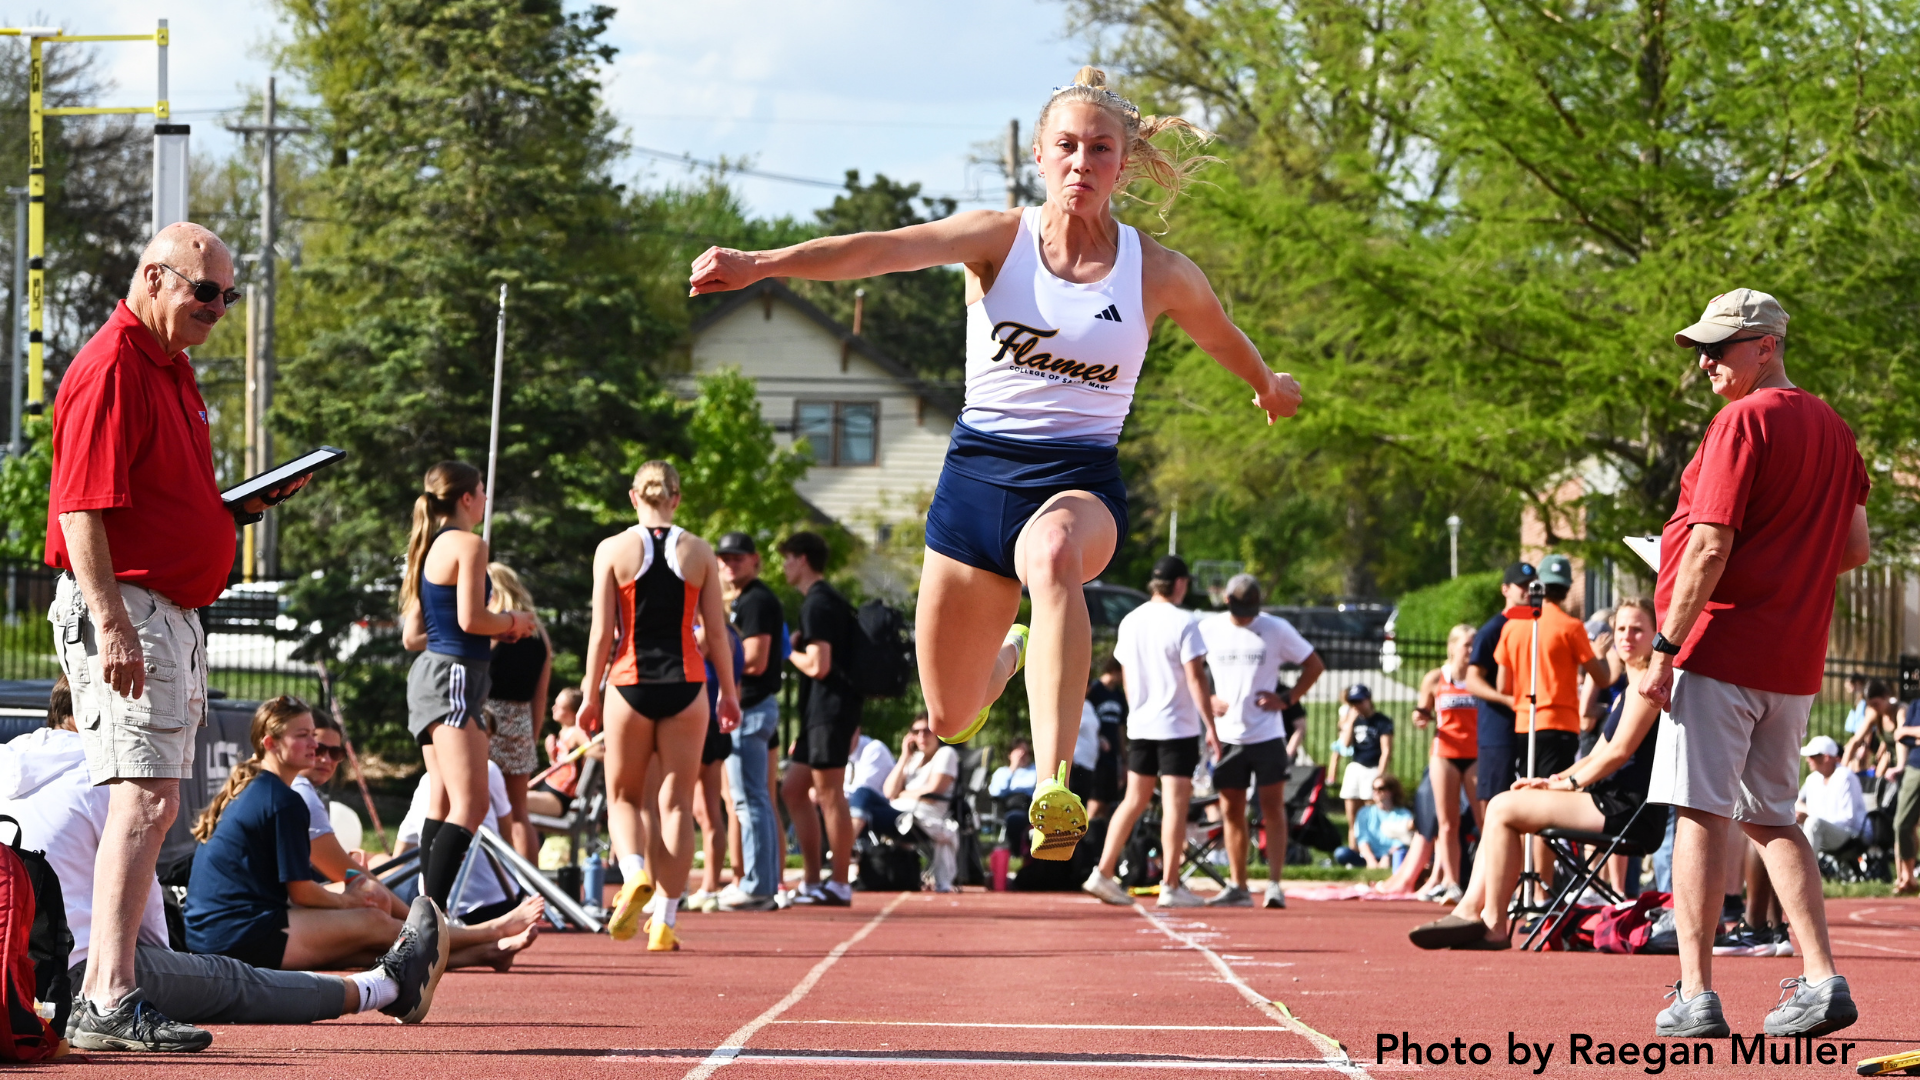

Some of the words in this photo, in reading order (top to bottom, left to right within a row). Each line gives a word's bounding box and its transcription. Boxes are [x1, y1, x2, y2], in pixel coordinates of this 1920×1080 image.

[32, 59, 40, 93] UCS
[991, 321, 1119, 383] Flames
[1010, 365, 1046, 378] COLLEGE
[1089, 381, 1110, 391] MARY
